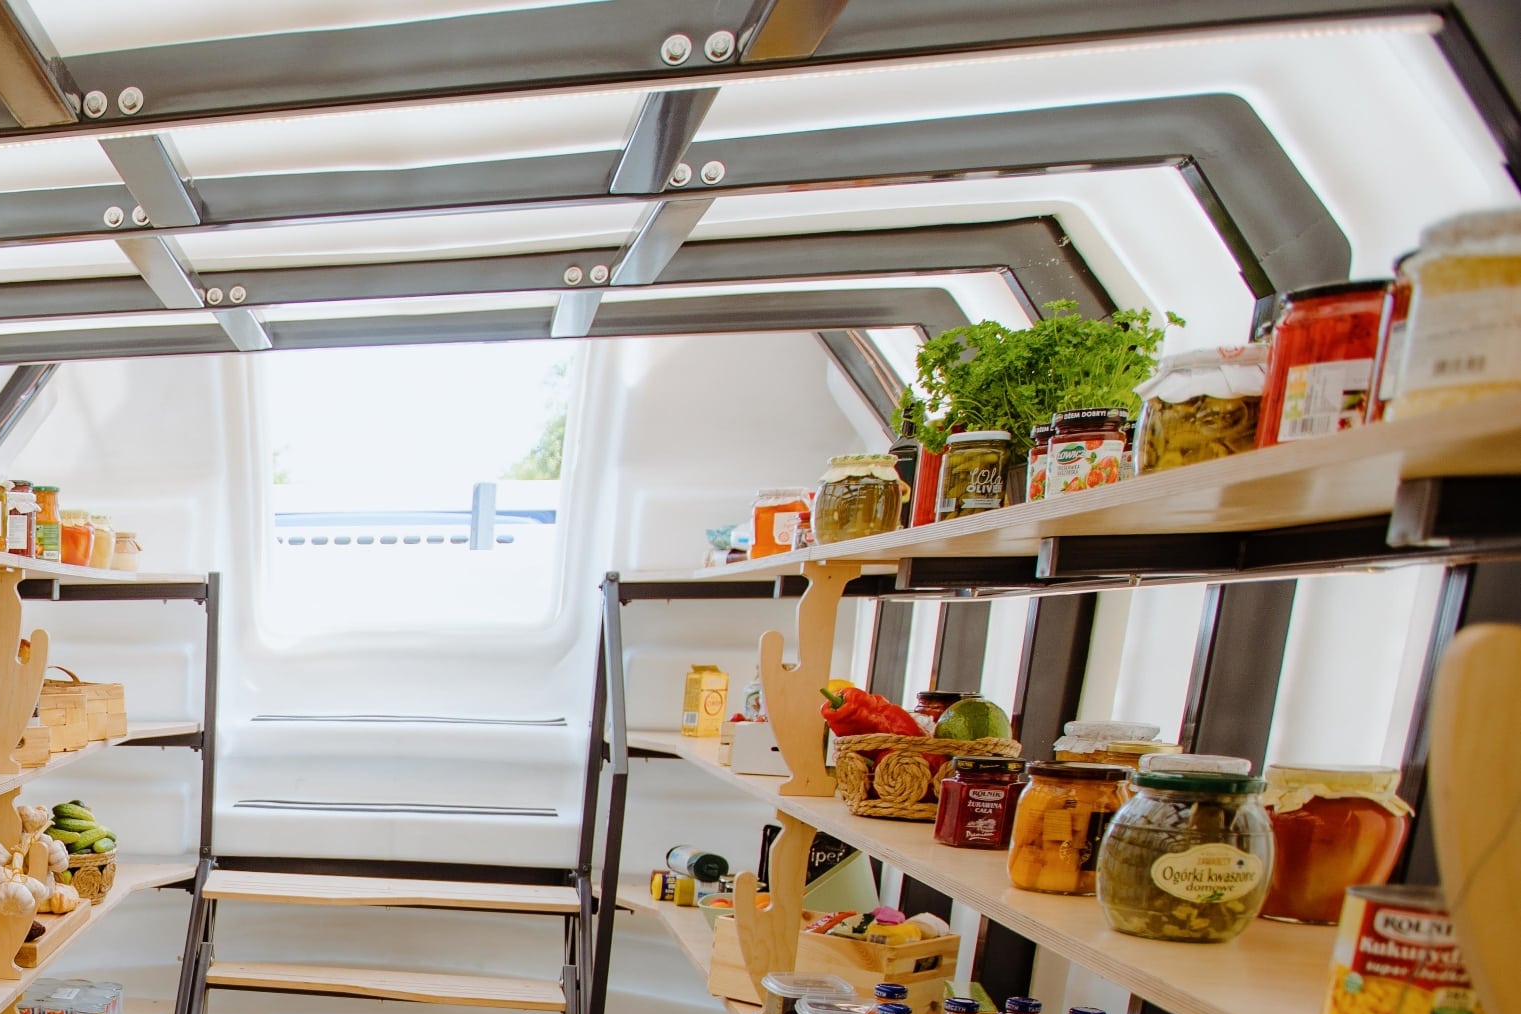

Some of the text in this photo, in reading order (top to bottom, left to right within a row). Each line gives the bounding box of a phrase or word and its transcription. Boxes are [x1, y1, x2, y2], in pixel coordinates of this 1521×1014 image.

[971, 790, 1002, 798] ROLNIK
[967, 800, 1002, 809] ŻURAWINA
[1162, 865, 1256, 885] Ogórki kwaszone
[1185, 883, 1235, 892] domowe
[1384, 917, 1453, 936] ROLNI
